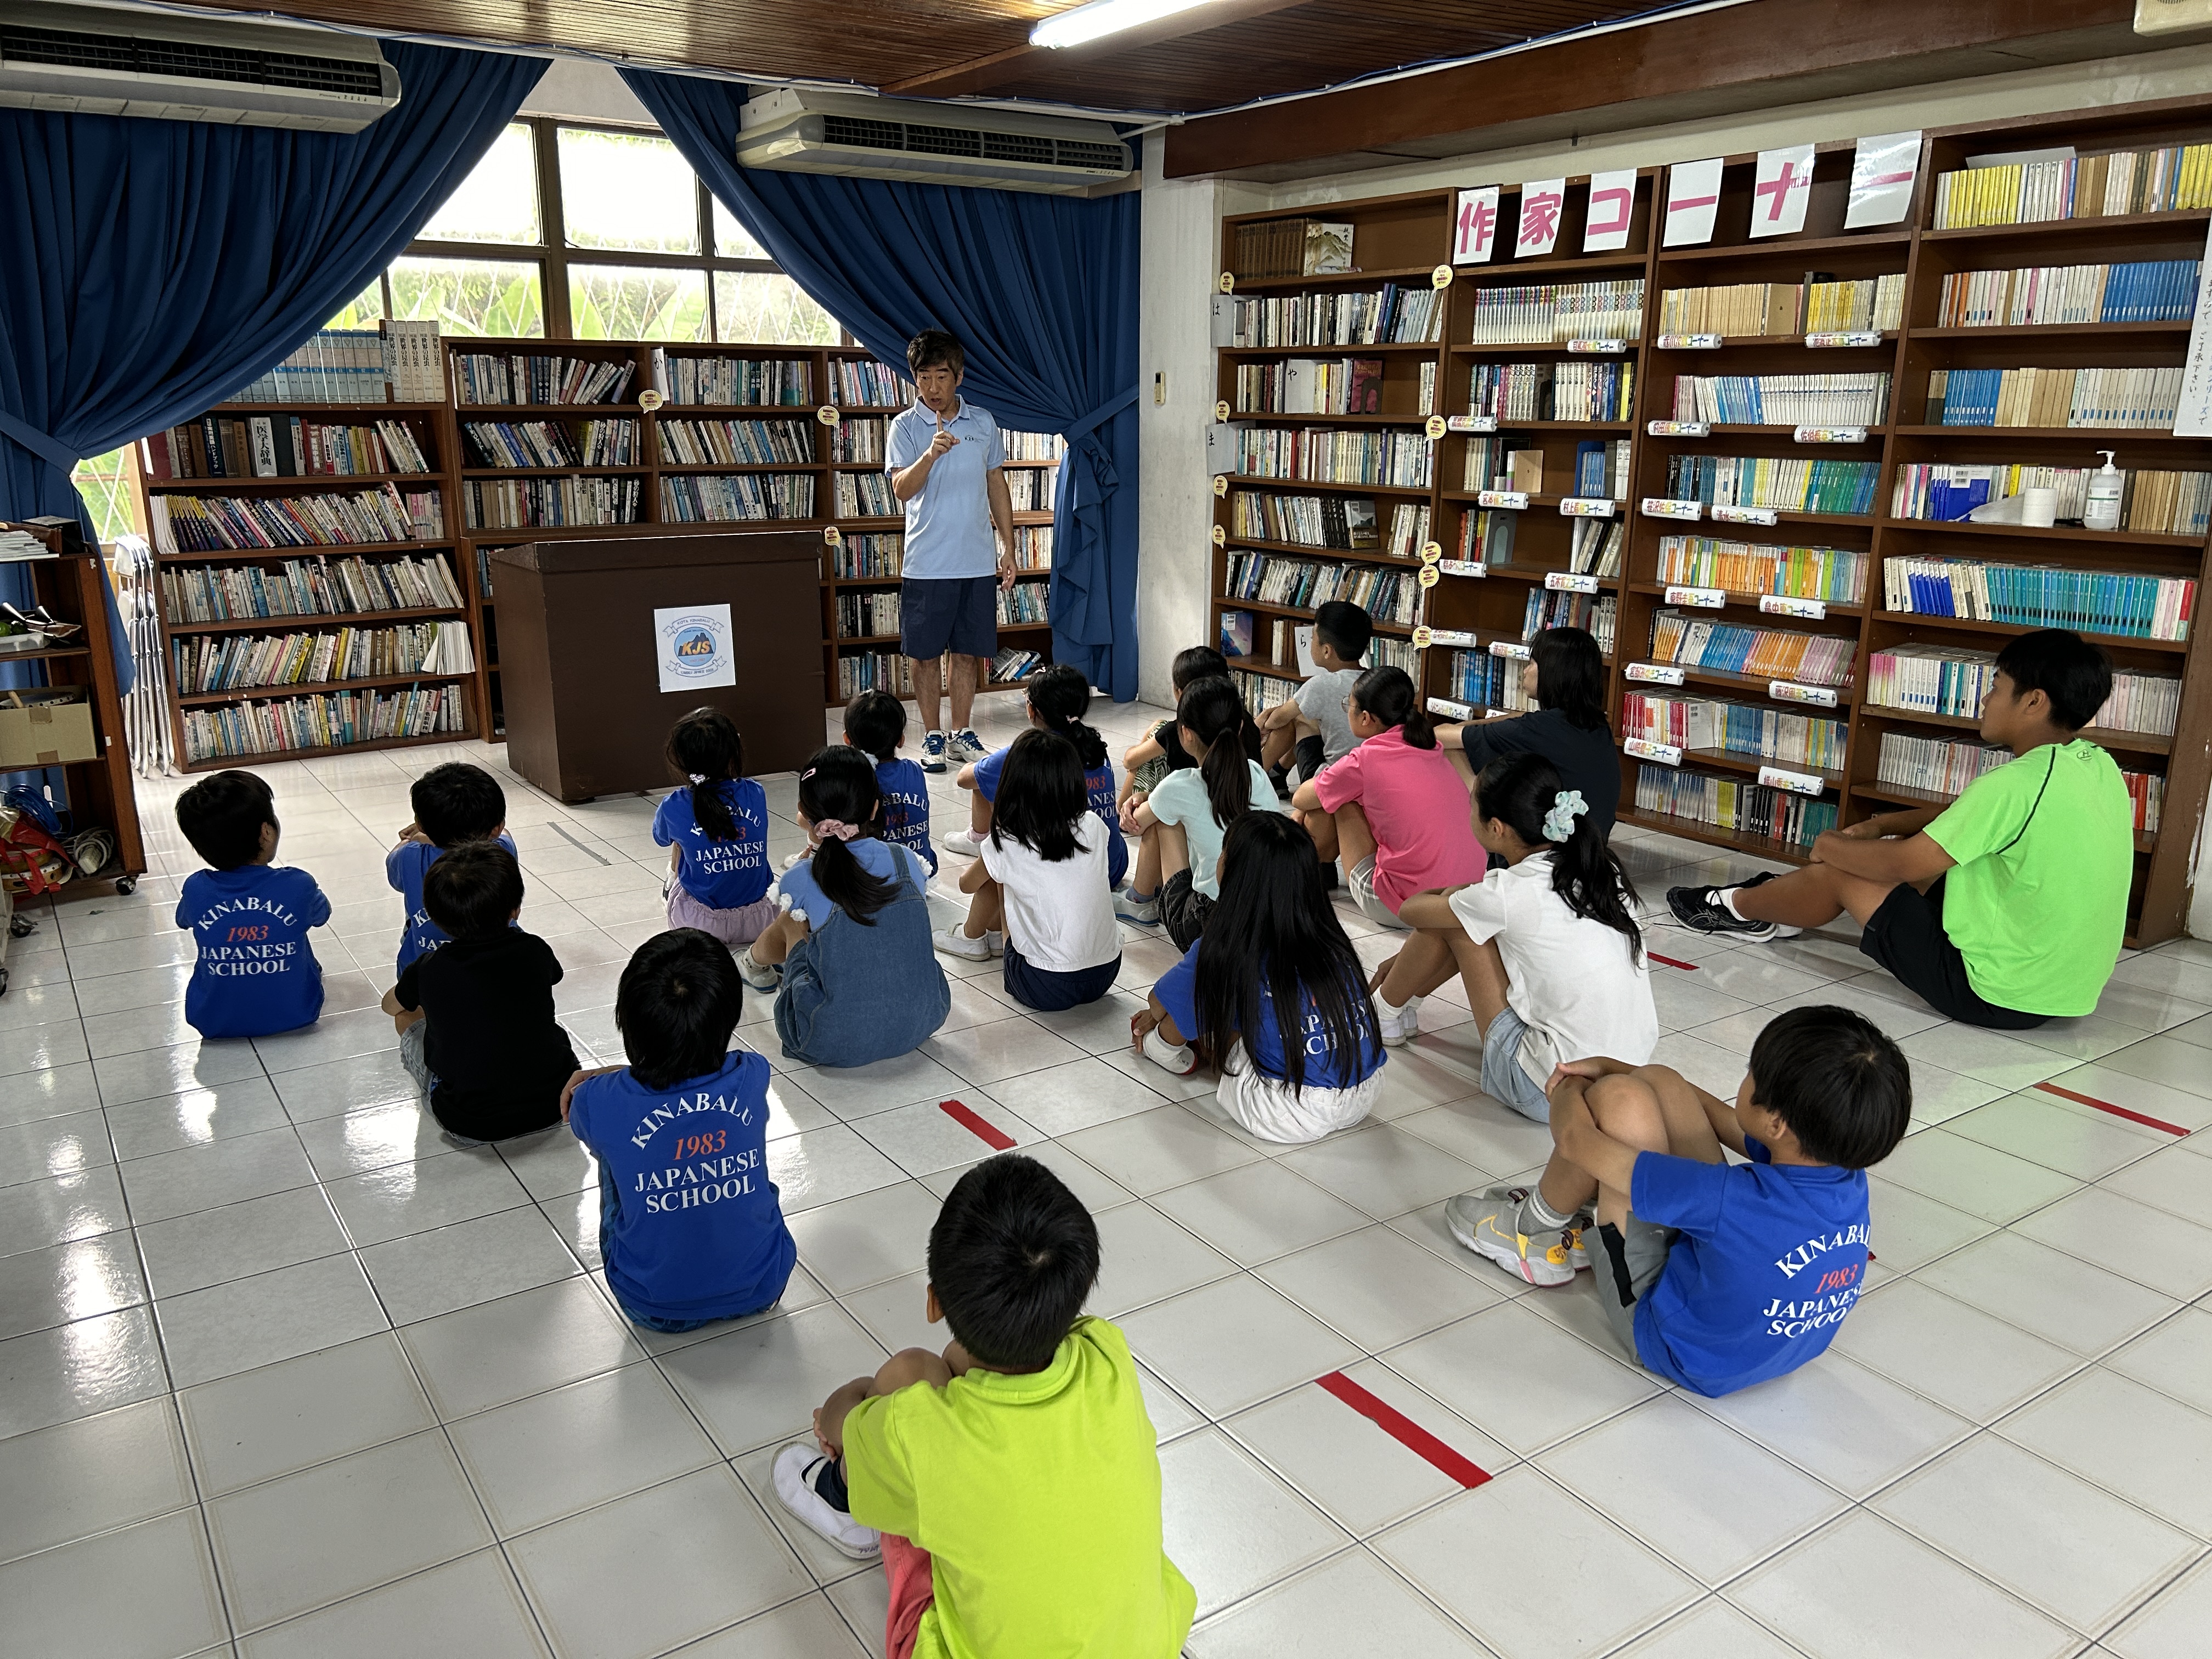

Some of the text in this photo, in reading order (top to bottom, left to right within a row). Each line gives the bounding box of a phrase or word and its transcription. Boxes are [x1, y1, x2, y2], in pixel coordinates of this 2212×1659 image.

[1212, 303, 1220, 316] は
[654, 357, 663, 370] か
[1288, 369, 1297, 381] や
[256, 426, 272, 466] 医学大辞典
[1208, 432, 1215, 446] ま
[681, 641, 710, 656] KJS
[1300, 634, 1307, 648] ら
[1085, 775, 1106, 791] 983
[882, 792, 927, 811] ABALU
[690, 805, 761, 837] KBALU
[695, 840, 764, 862] JAPANESE
[703, 856, 762, 874] SCHOOL
[198, 896, 298, 931] KINABALU
[226, 925, 269, 943] 1983
[201, 941, 297, 960] JAPANESE
[207, 959, 291, 976] SCHOOL
[630, 1092, 753, 1150] KINABALU
[673, 1129, 727, 1161] 1983
[635, 1148, 760, 1192] JAPANESE
[645, 1175, 756, 1214] SCHOOL
[1774, 1223, 1870, 1280] KINABAL
[1813, 1263, 1859, 1294] 1983
[1763, 1279, 1863, 1318] JAPANES
[1767, 1303, 1852, 1339] SCHOO
